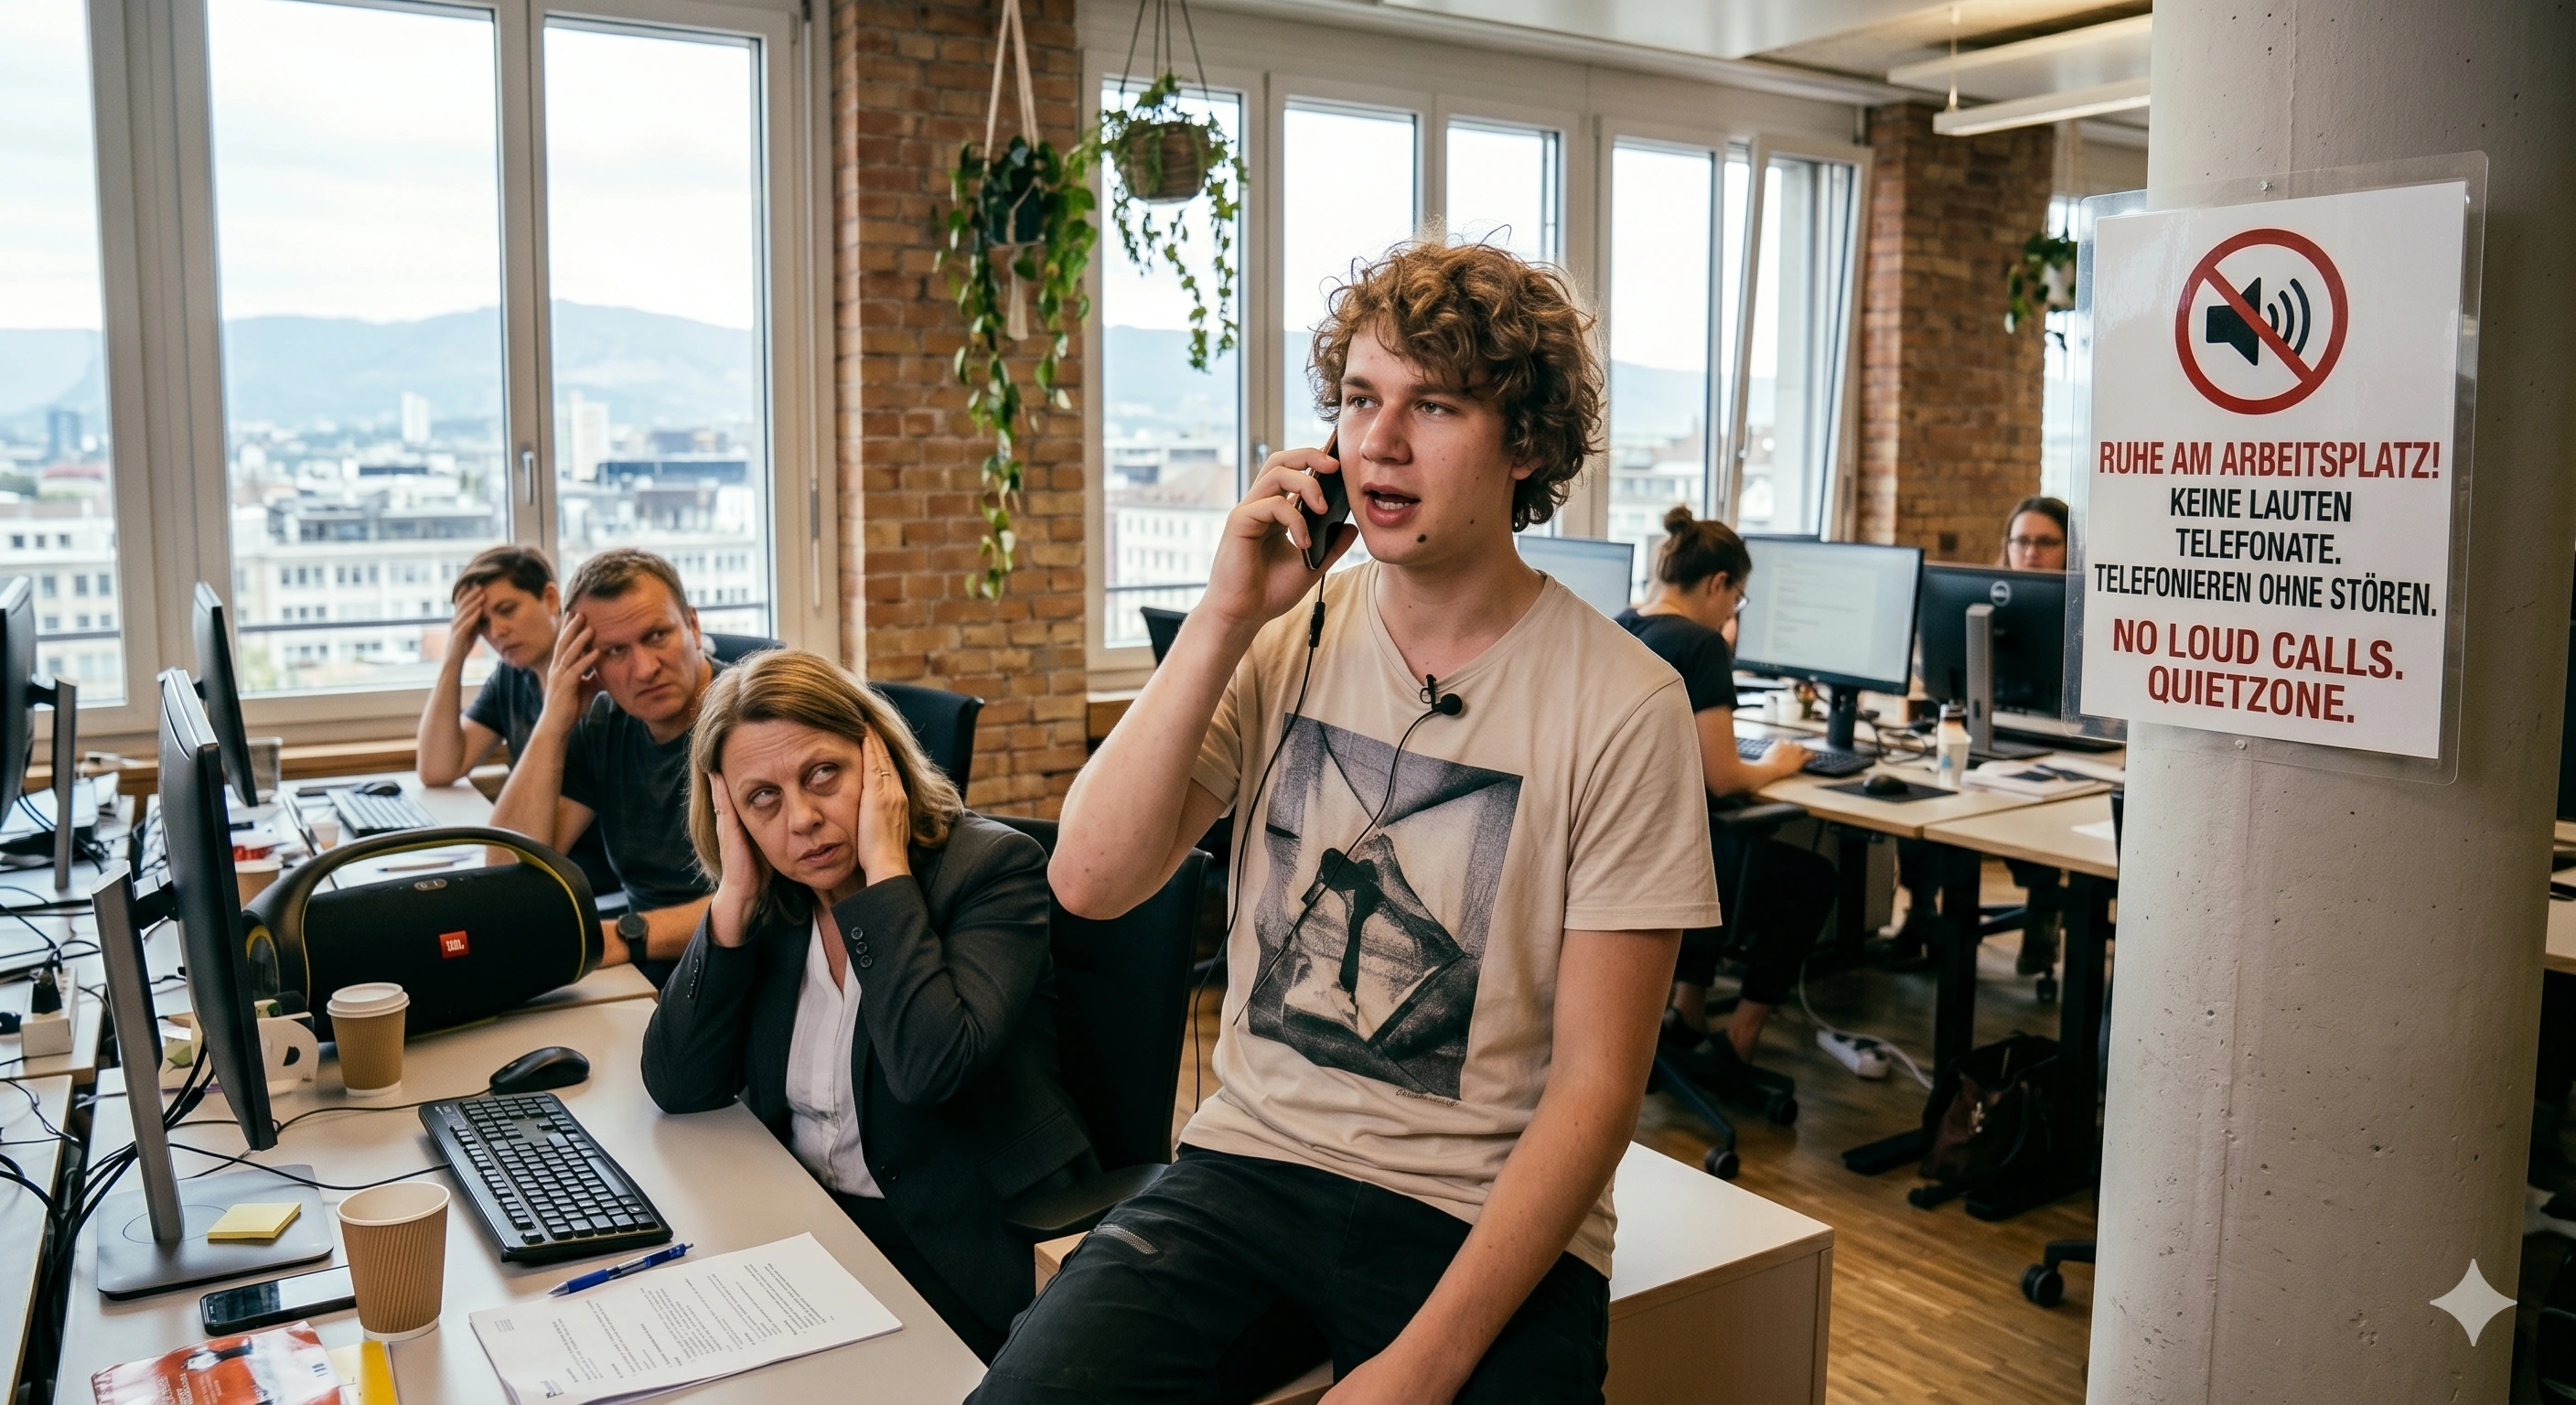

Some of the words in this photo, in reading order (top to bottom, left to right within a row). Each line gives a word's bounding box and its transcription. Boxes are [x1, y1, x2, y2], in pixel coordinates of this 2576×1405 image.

[2099, 441, 2164, 475] RUHE
[2170, 441, 2213, 476] AM
[2219, 441, 2441, 479] ARBEITSPLATZ!
[2170, 487, 2242, 519] KEINE
[2249, 488, 2352, 522] LAUTEN
[2175, 528, 2342, 565] TELEFONATE.
[2094, 563, 2252, 604] TELEFONIEREN
[2259, 573, 2324, 608] OHNE
[2330, 572, 2437, 617] STÖREN.
[2113, 617, 2158, 655] NO
[2168, 623, 2259, 665] LOUD
[2272, 631, 2403, 681] CALLS.
[2148, 665, 2355, 724] QUIETZONE.
